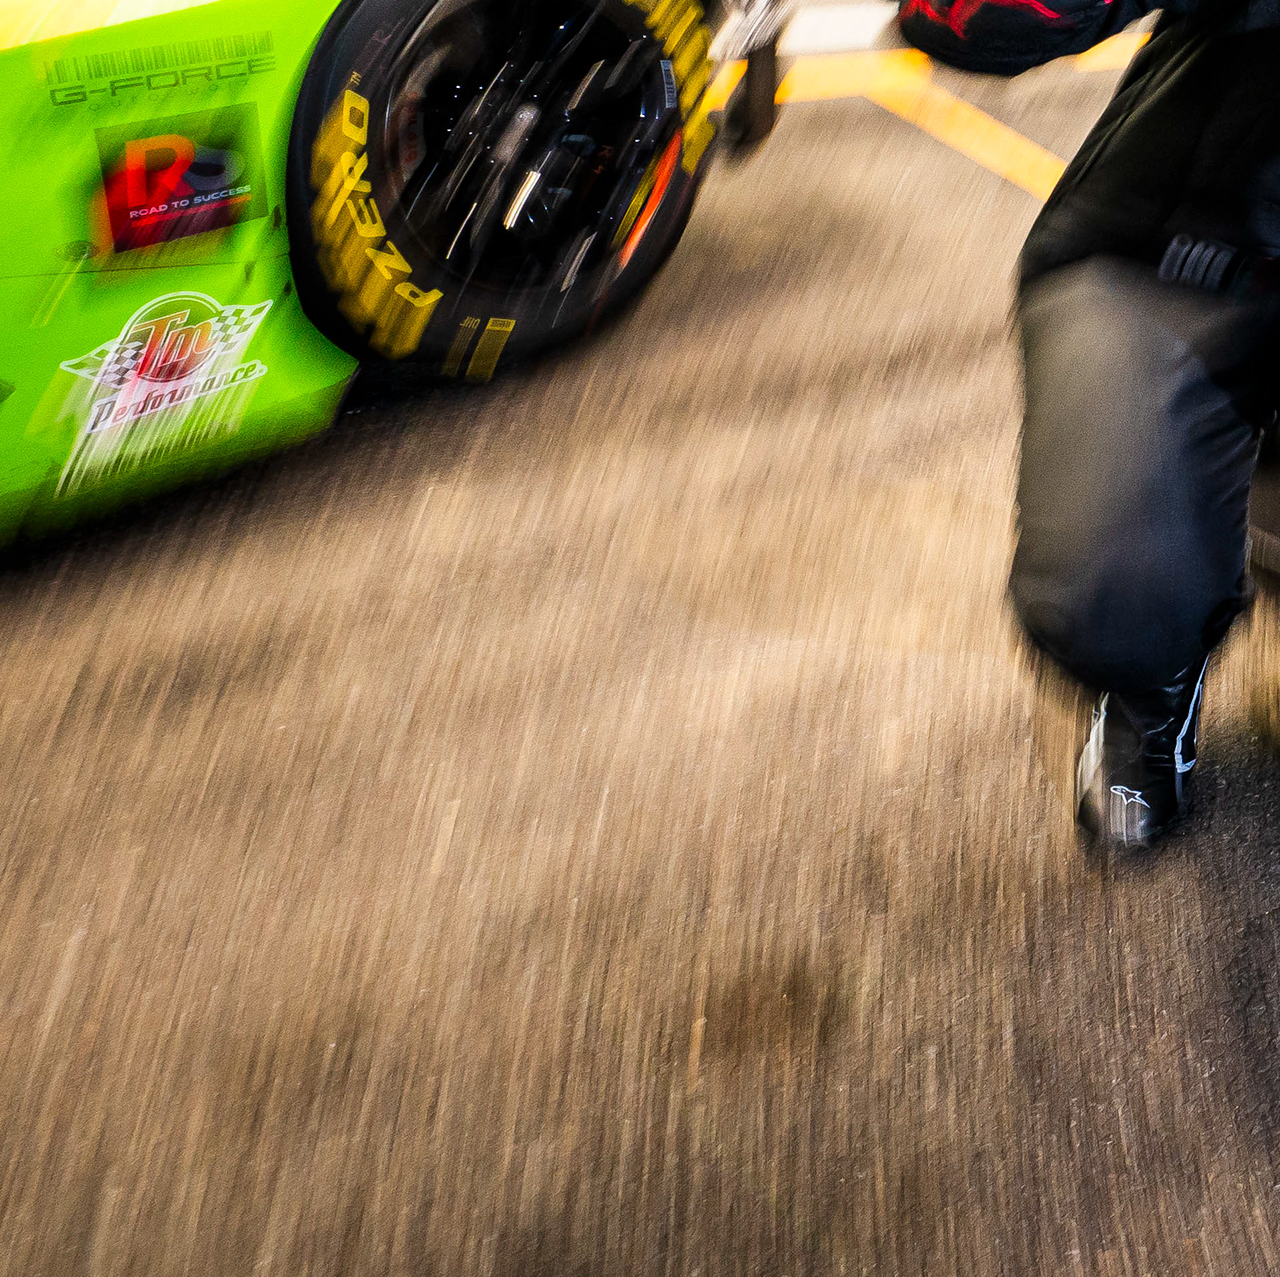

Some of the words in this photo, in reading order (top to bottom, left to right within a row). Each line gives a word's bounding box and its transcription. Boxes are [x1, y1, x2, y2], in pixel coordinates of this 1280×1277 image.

[50, 56, 277, 106] G-FORCE
[129, 204, 167, 218] ROAD
[171, 199, 190, 209] TO
[193, 184, 251, 204] SUCCESS
